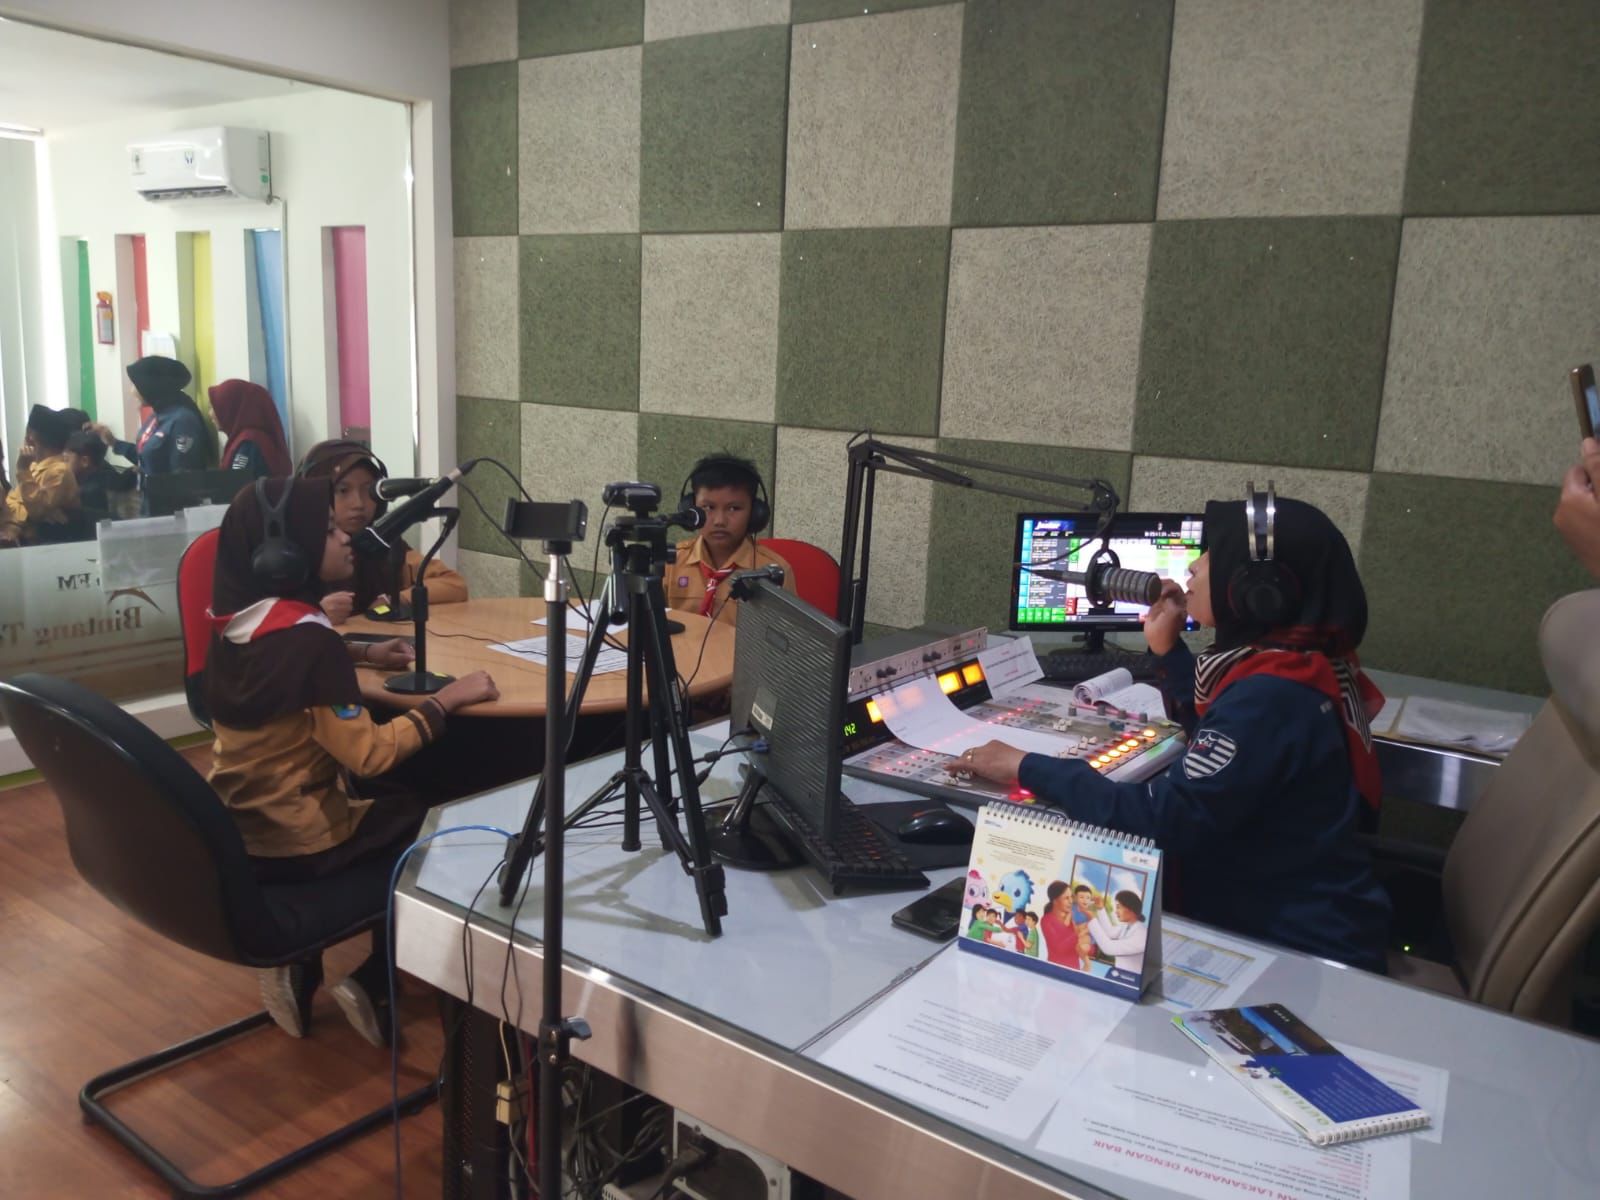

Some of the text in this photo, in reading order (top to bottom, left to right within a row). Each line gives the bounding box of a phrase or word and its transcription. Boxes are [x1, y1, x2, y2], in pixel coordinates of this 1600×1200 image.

[1093, 1140, 1122, 1153] BAIK
[1125, 1149, 1181, 1171] DENGAN
[1183, 1166, 1273, 1197] LAKSANAKAN
